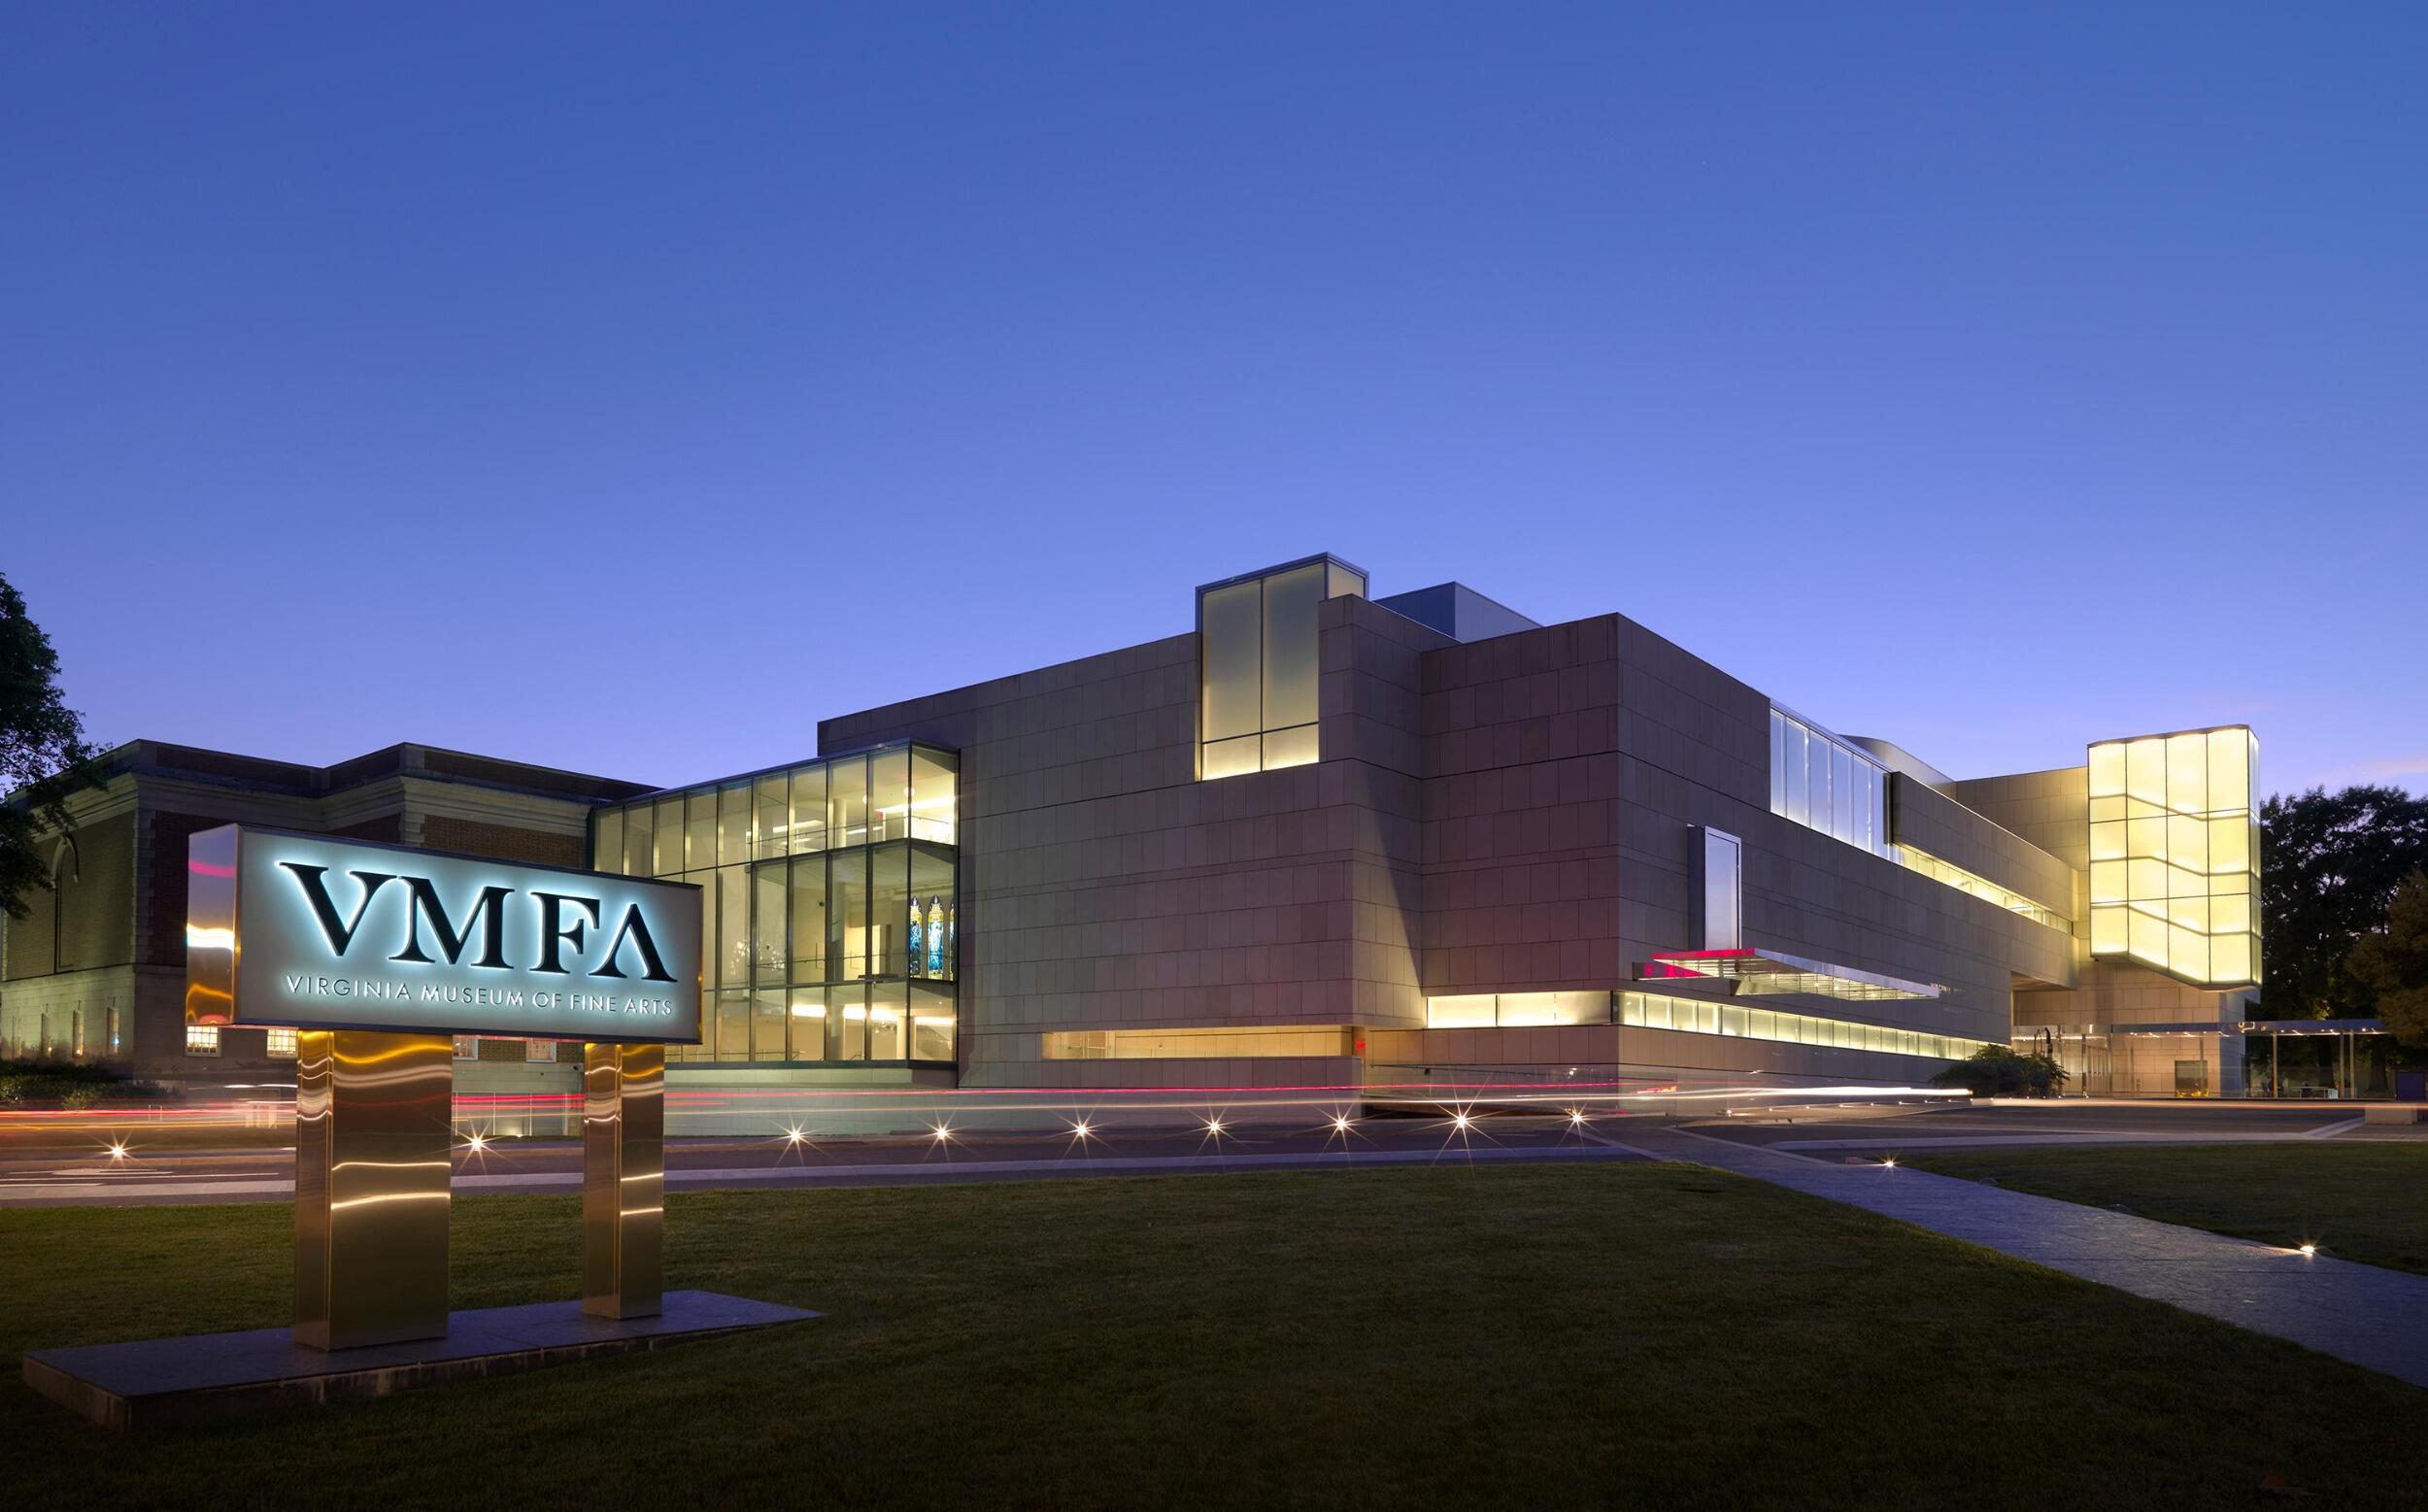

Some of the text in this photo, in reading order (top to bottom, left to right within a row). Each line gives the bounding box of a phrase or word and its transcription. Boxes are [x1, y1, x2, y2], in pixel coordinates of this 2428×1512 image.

[277, 861, 679, 983] VMFA
[287, 975, 672, 1016] VIRGINIA MUSEUM OF FINE ARTS
